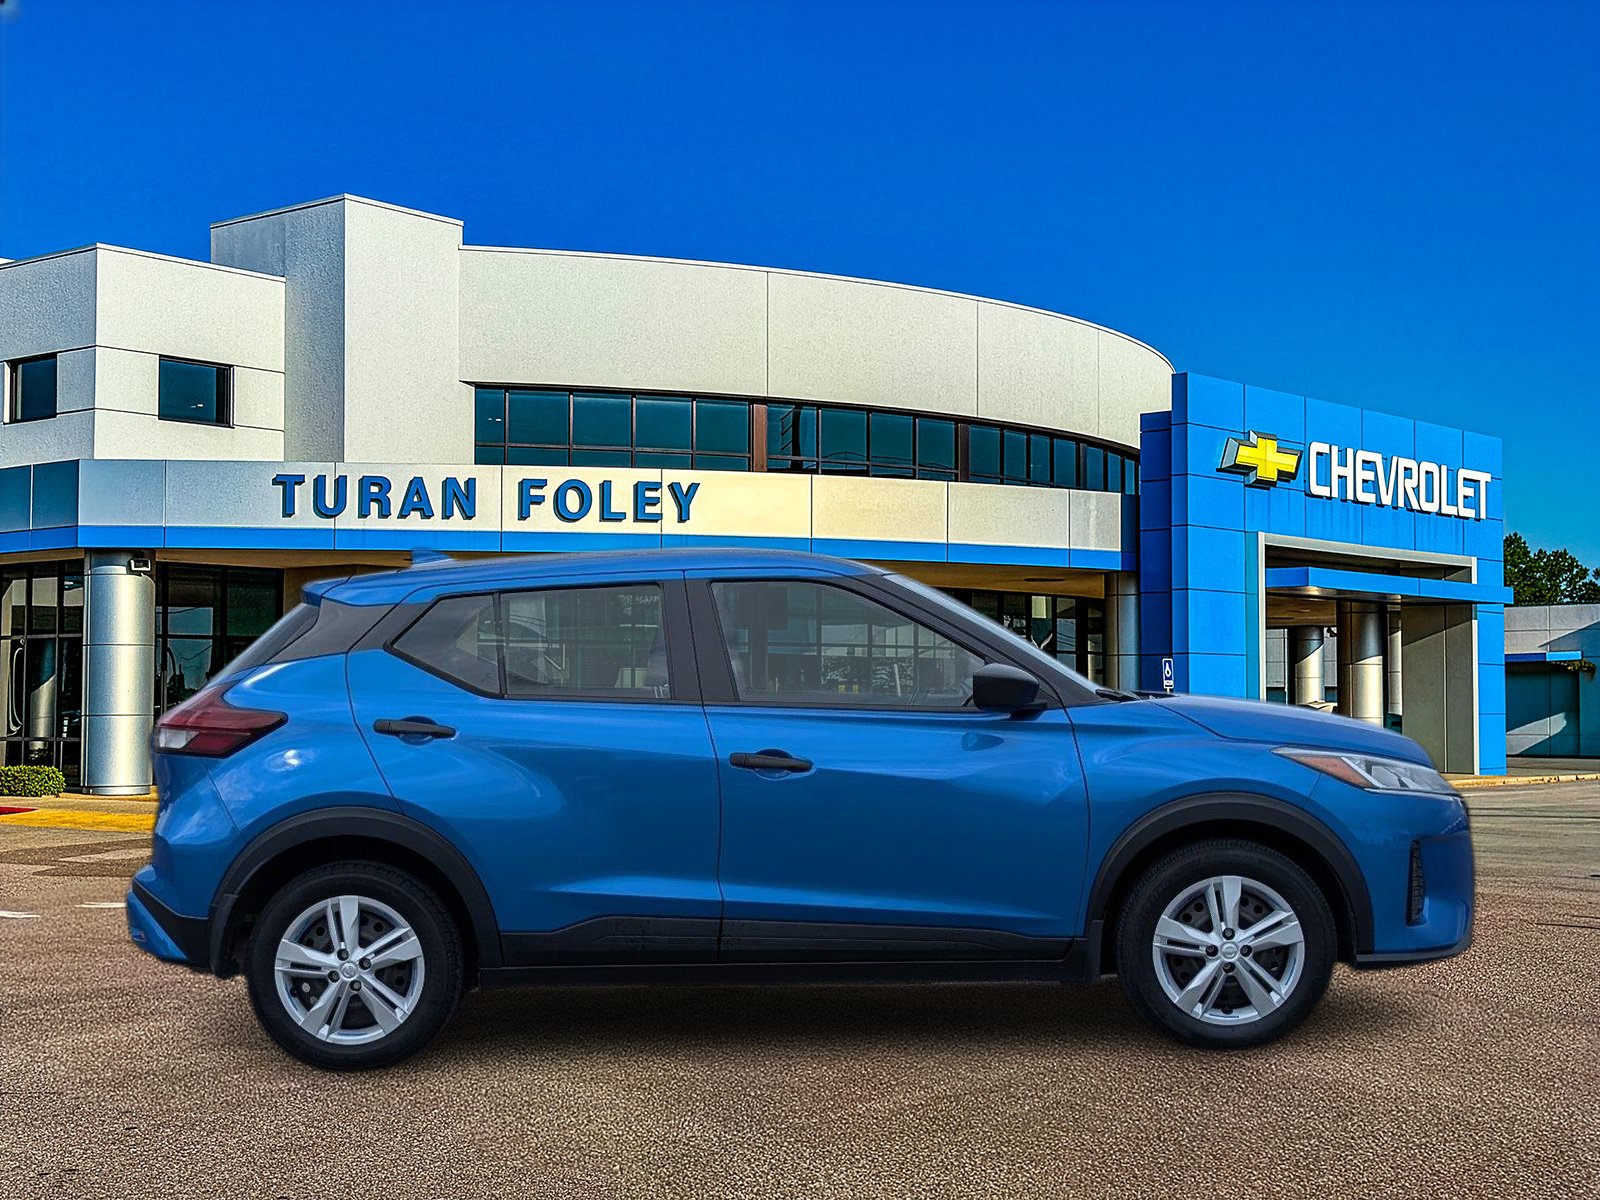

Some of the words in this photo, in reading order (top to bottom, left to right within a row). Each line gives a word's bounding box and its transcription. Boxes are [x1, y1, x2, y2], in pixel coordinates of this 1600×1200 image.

[272, 473, 477, 519] TURAN
[518, 477, 701, 523] FOLEY
[1307, 440, 1492, 520] CHEVROLET
